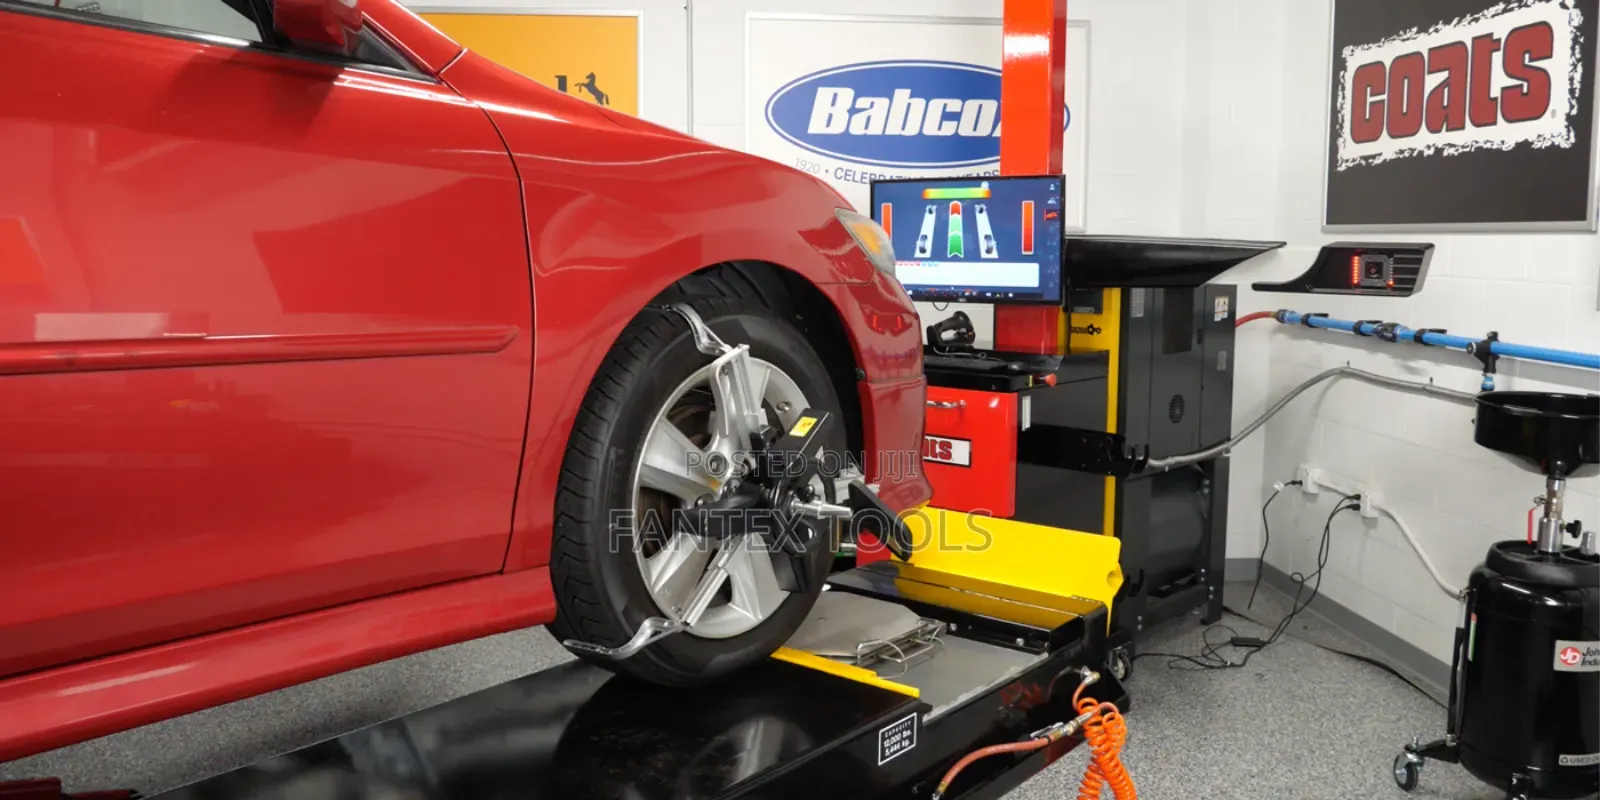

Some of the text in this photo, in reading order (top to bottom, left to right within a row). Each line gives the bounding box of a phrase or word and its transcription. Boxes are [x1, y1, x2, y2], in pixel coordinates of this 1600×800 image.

[807, 86, 1001, 138] Babco
[794, 157, 821, 175] 1920
[884, 720, 911, 738] CAPACITY
